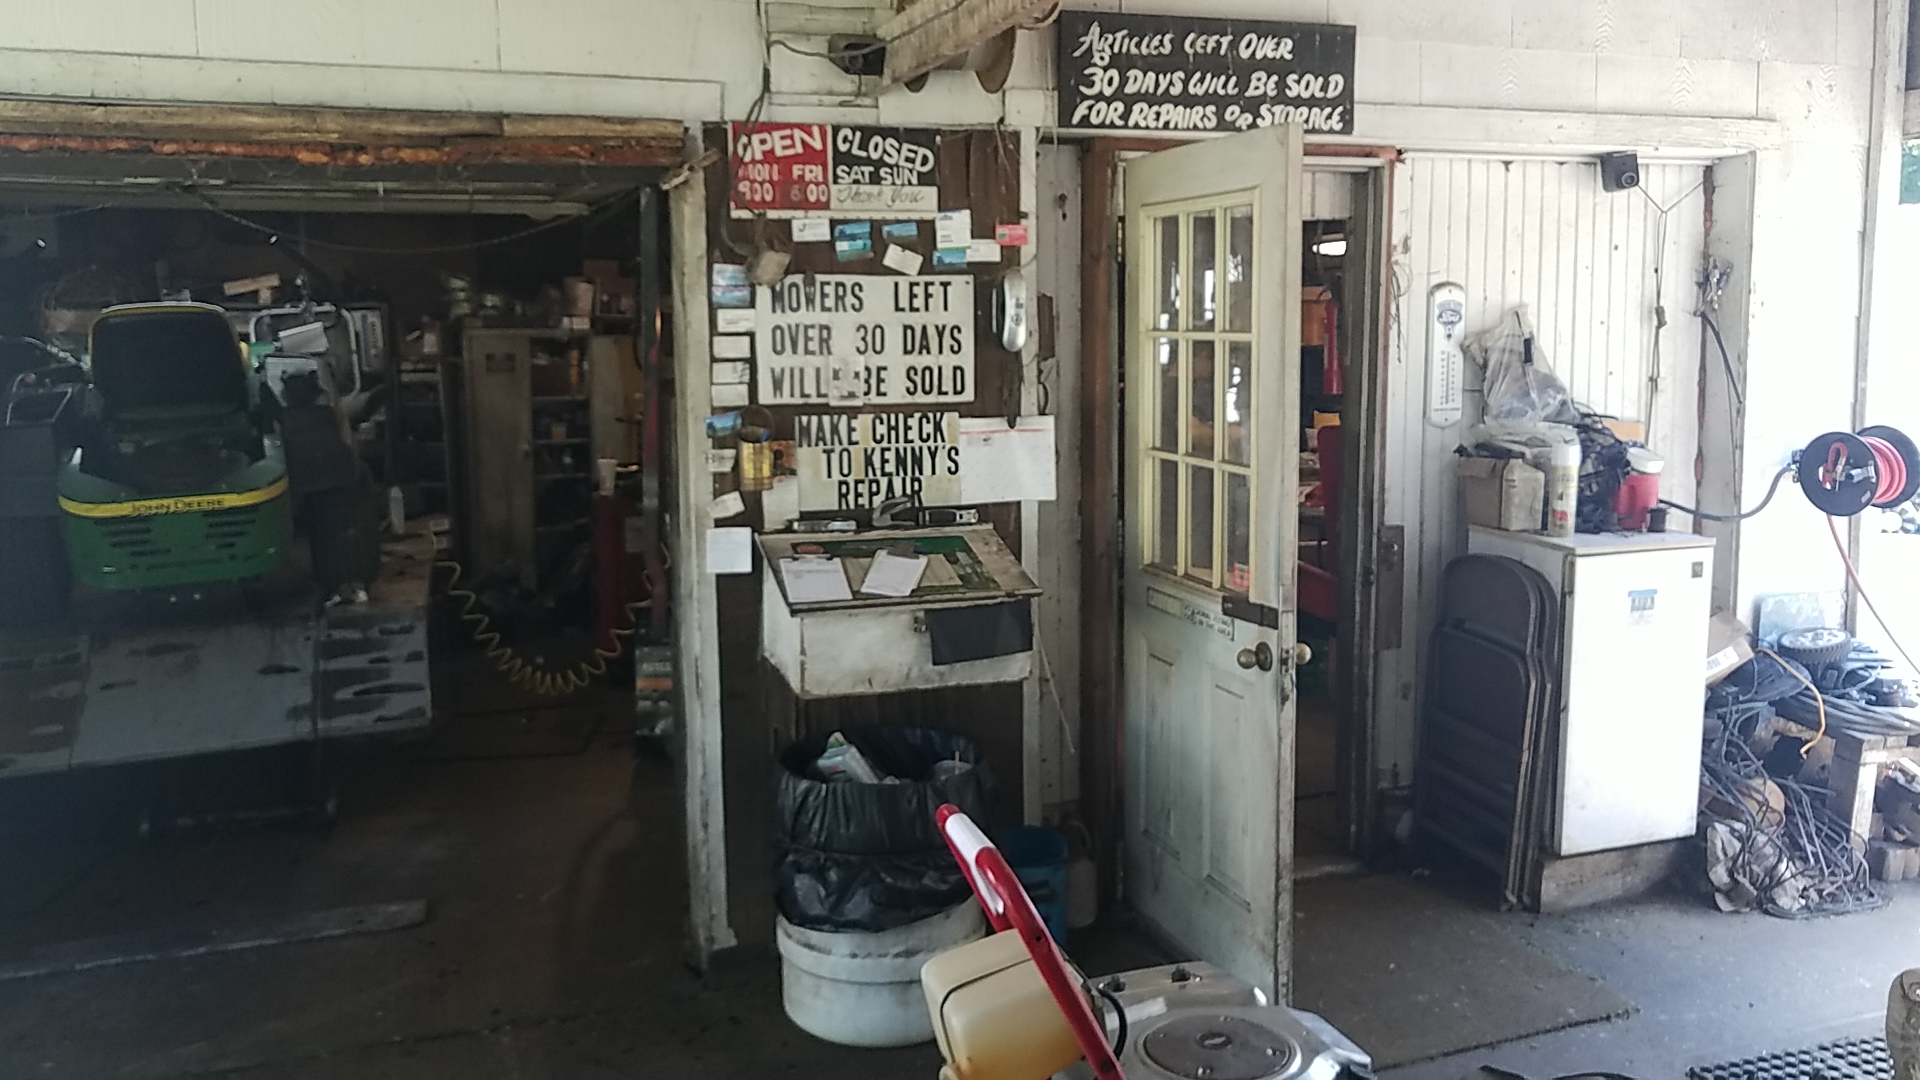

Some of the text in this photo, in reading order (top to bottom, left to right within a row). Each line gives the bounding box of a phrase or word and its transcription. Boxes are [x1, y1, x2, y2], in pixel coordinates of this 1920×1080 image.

[1072, 21, 1294, 66] ARTICLES LEFT OVER
[1079, 66, 1344, 98] 30 DAYS WILL BE SOLD
[1071, 100, 1344, 131] FOR REPAIRS OR STORAGE
[737, 125, 823, 163] OPEN
[836, 127, 935, 173] CLOSED
[791, 164, 823, 182] FRI
[836, 165, 918, 185] SAT SUN
[771, 281, 952, 313] MOWERS LEFT
[771, 323, 962, 356] OVER 30 DAYS
[770, 365, 965, 399] WILL BE SOLD
[798, 413, 946, 447] MAKE CHECK
[822, 444, 960, 479] TO KENNY'S
[132, 498, 225, 514] JOHN DEERE
[838, 476, 923, 510] REPAIR
